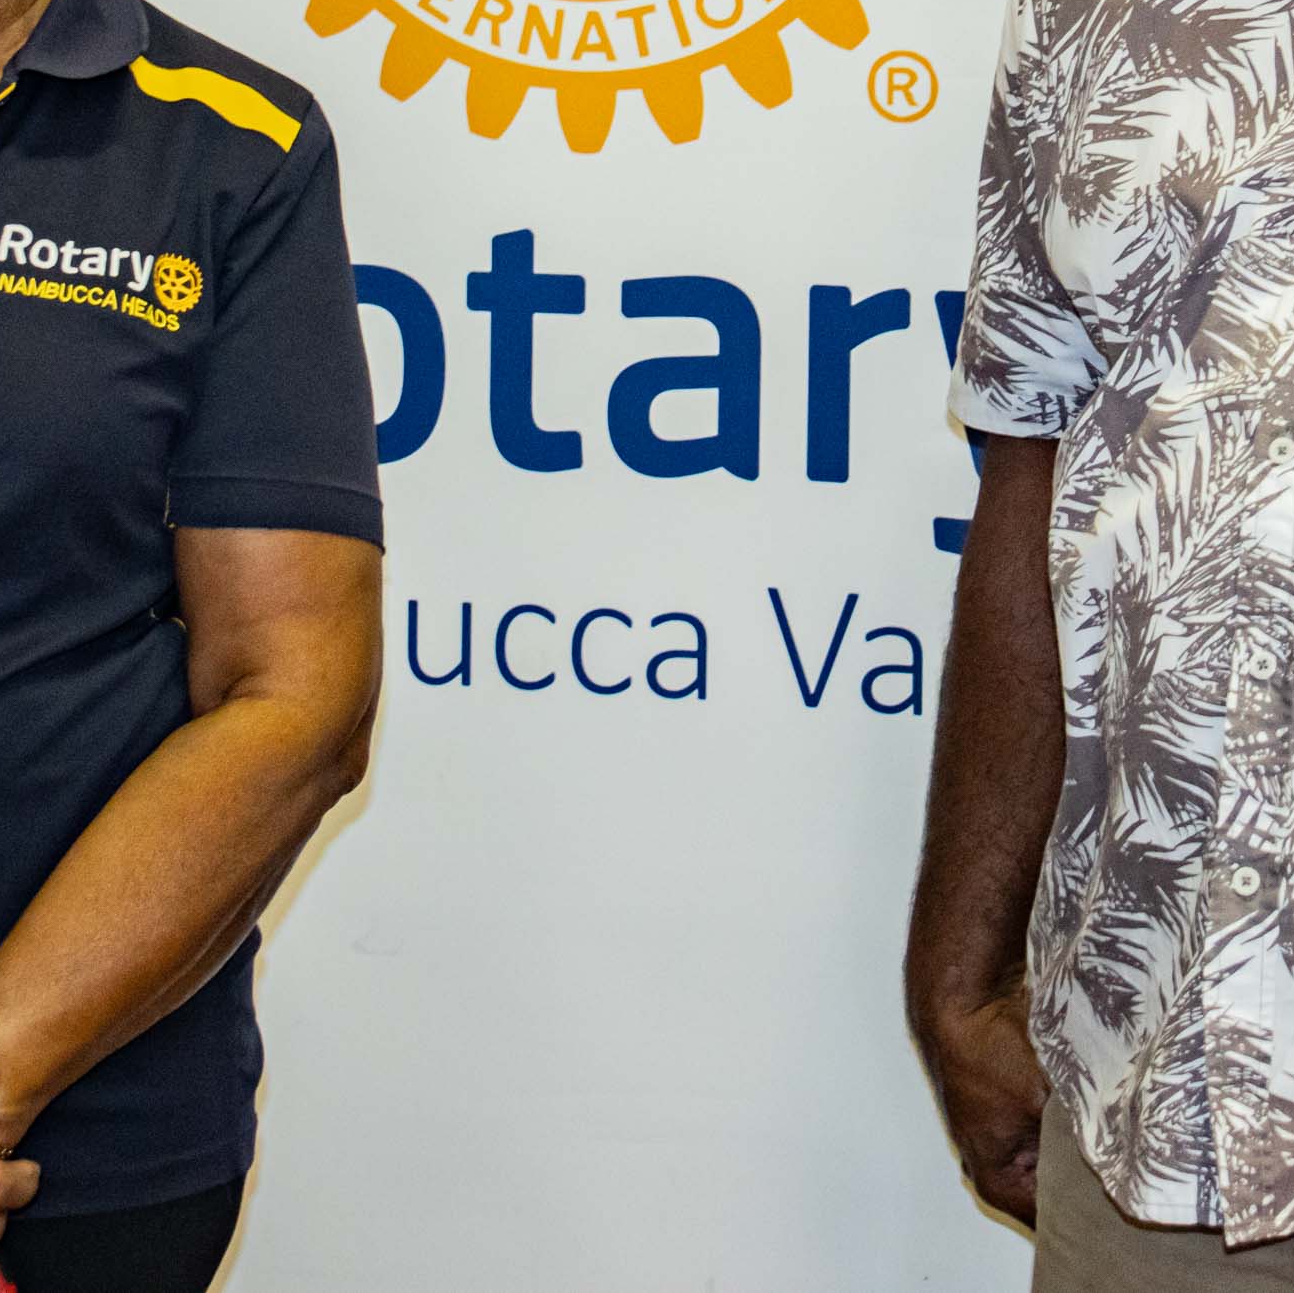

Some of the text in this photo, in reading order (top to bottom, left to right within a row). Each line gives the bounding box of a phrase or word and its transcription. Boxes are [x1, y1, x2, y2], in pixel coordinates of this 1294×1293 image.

[121, 293, 180, 332] HEADS
[407, 587, 923, 716] ucca Va
